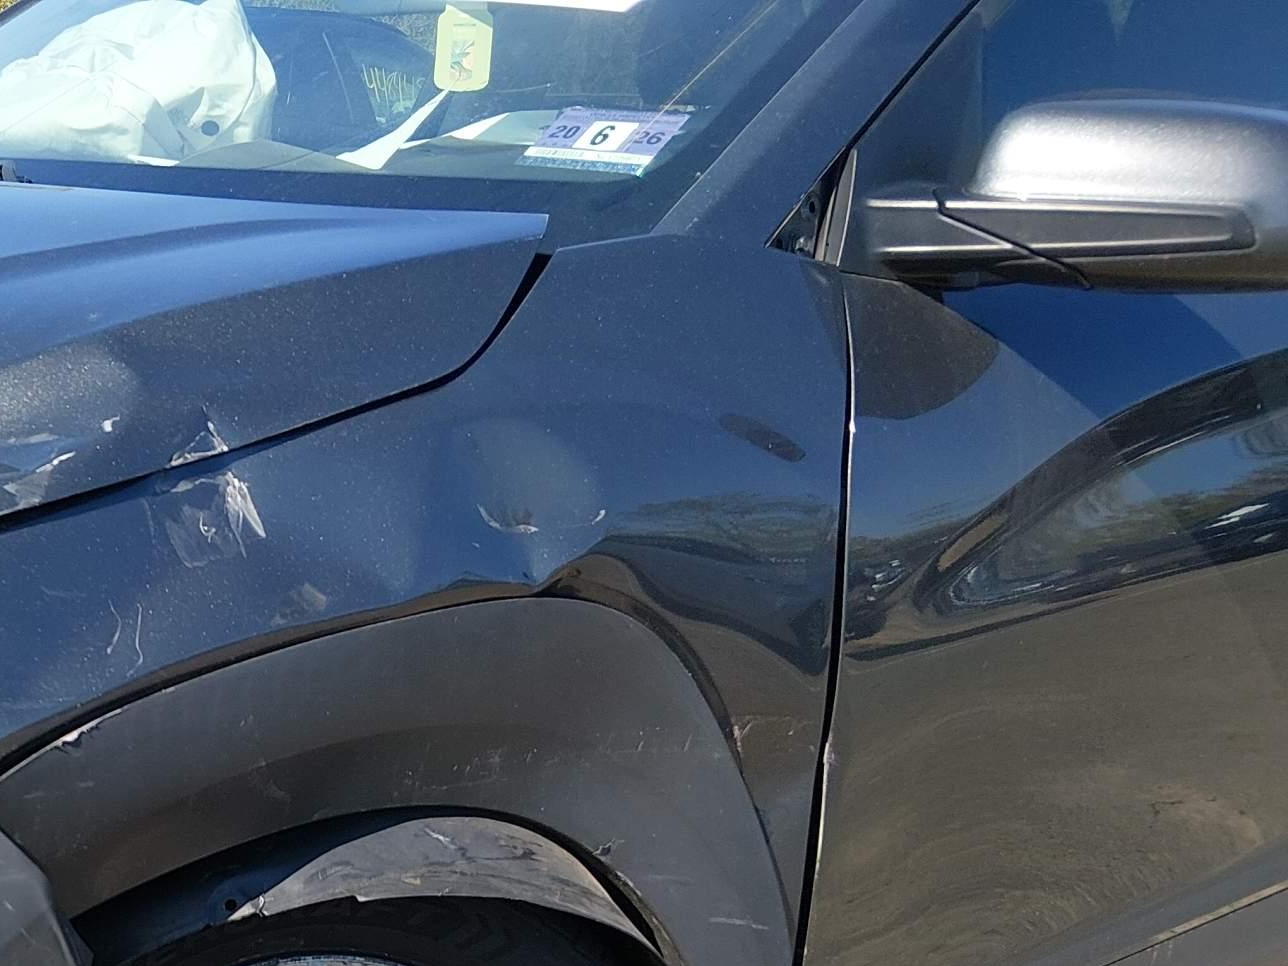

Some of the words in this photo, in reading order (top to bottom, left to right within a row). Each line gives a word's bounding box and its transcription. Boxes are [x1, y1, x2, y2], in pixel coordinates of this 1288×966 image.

[548, 124, 581, 139] 20
[589, 124, 616, 146] 6
[633, 129, 666, 145] 26
